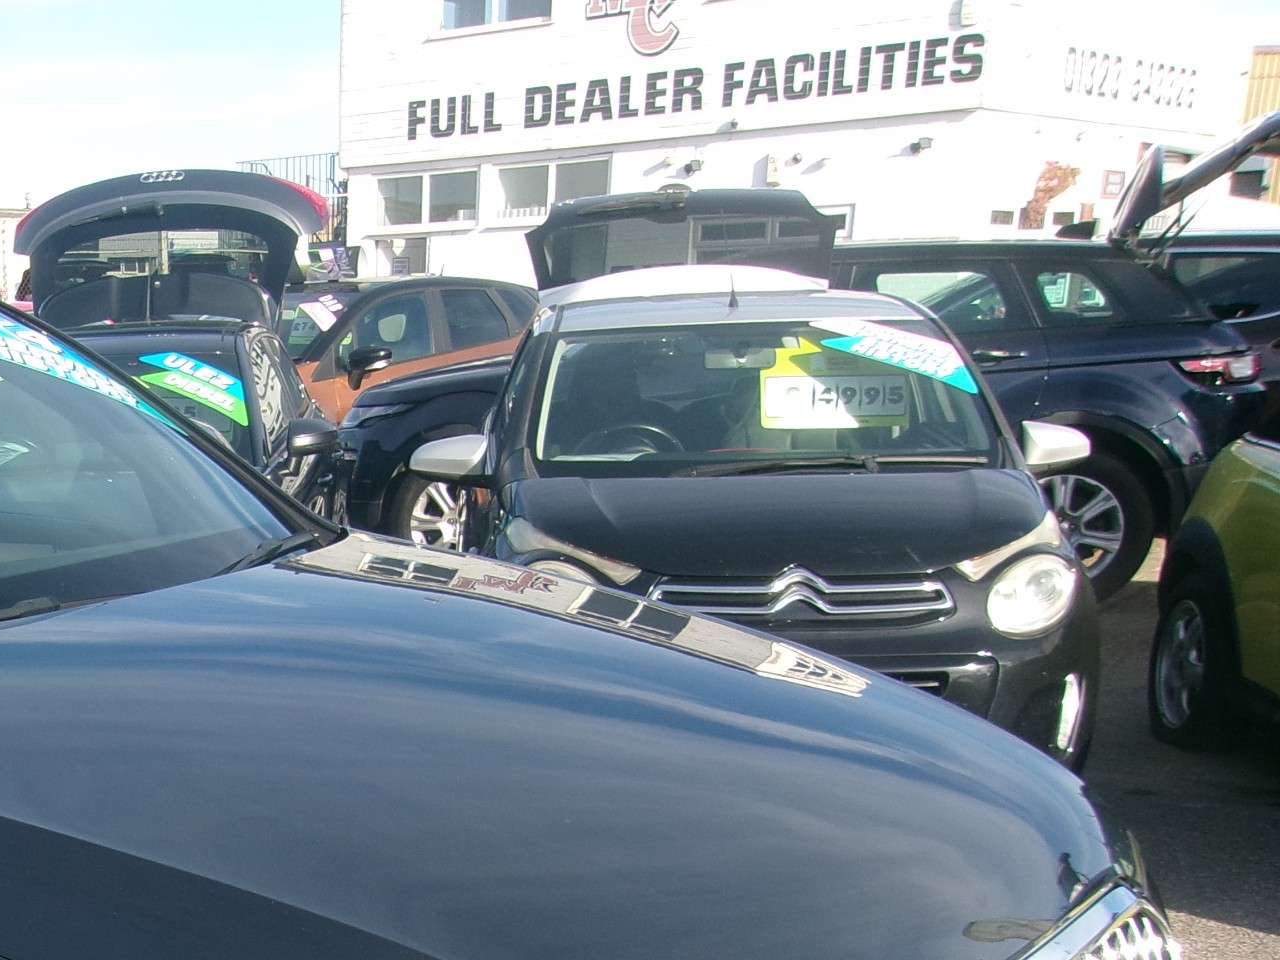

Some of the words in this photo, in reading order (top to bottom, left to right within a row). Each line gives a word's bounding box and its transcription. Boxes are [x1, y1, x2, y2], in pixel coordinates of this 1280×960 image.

[407, 91, 503, 141] FULL
[523, 66, 704, 130] DEALER
[721, 32, 985, 108] FACILITIES
[163, 354, 237, 390] ULEZ
